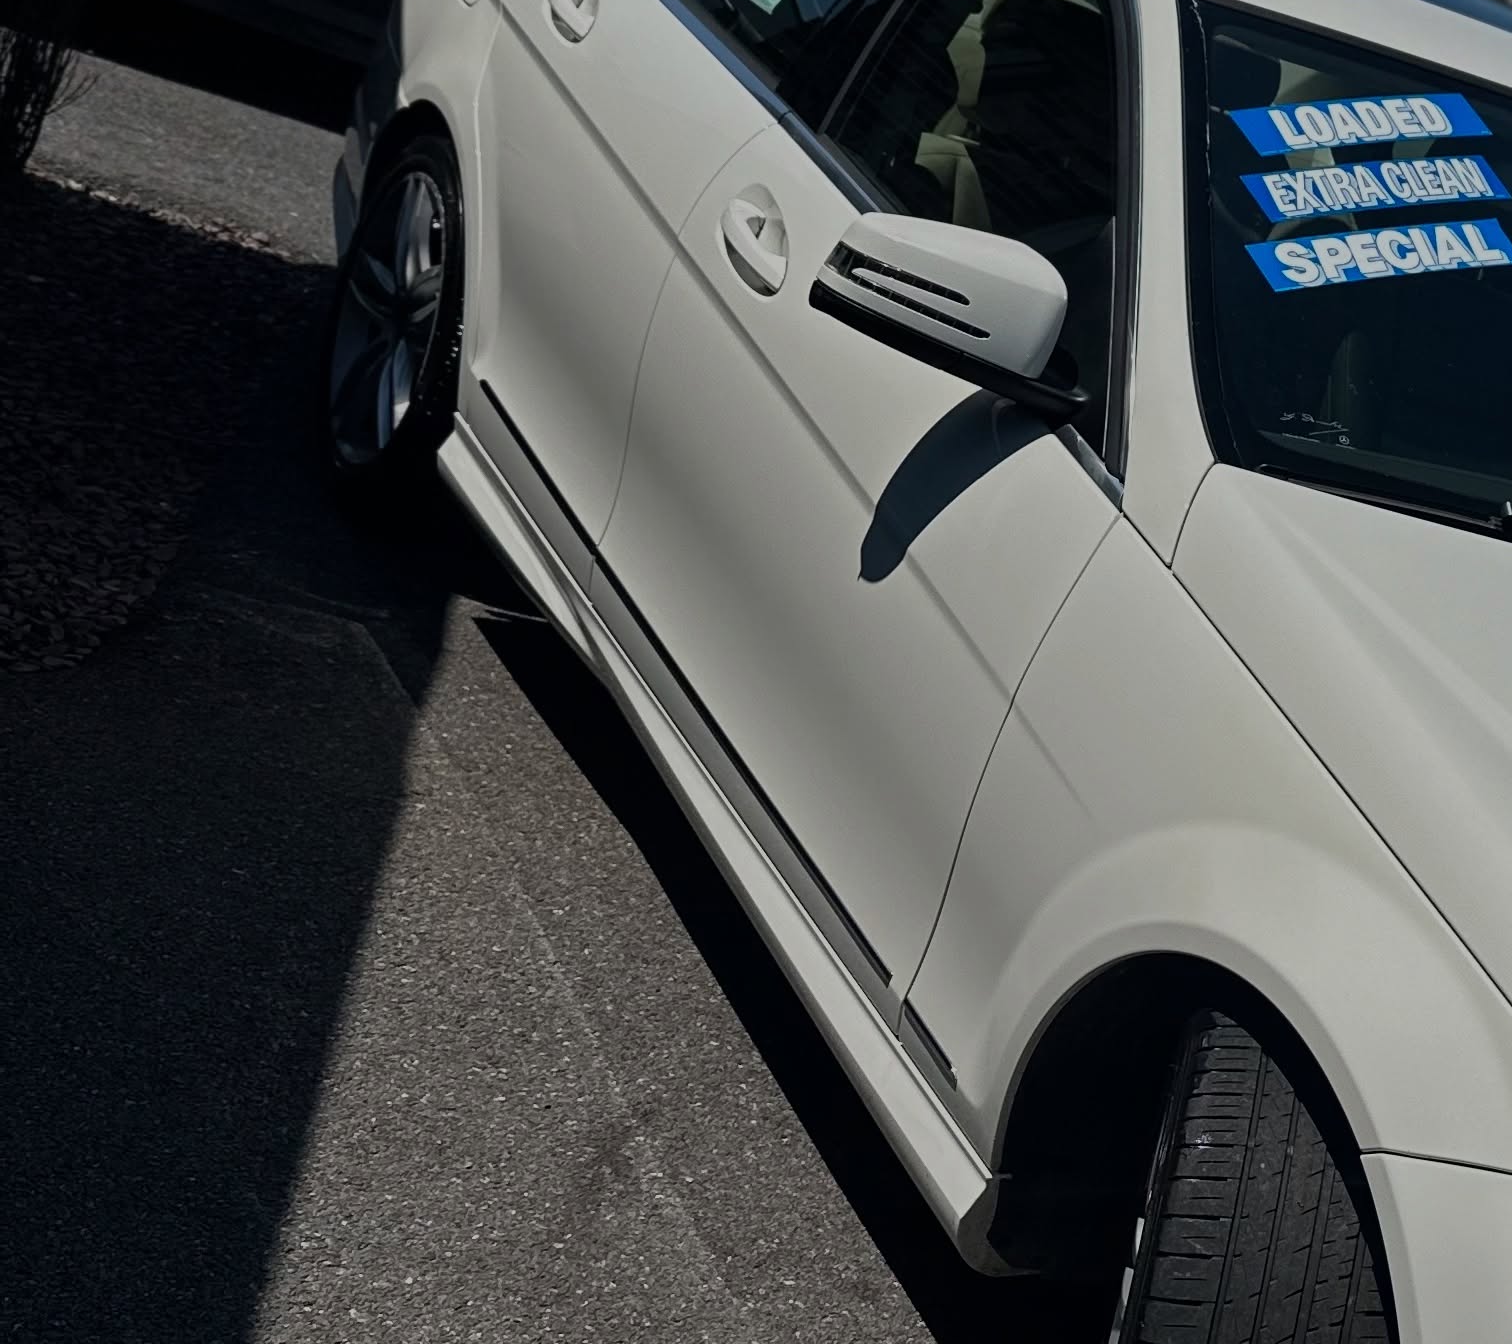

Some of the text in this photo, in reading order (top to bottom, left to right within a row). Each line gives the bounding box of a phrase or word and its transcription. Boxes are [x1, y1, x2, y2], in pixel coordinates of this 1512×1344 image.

[1268, 97, 1453, 150] LOADED
[1262, 157, 1494, 218] EXTRA CLEAN
[1274, 223, 1510, 287] SPECIAL
